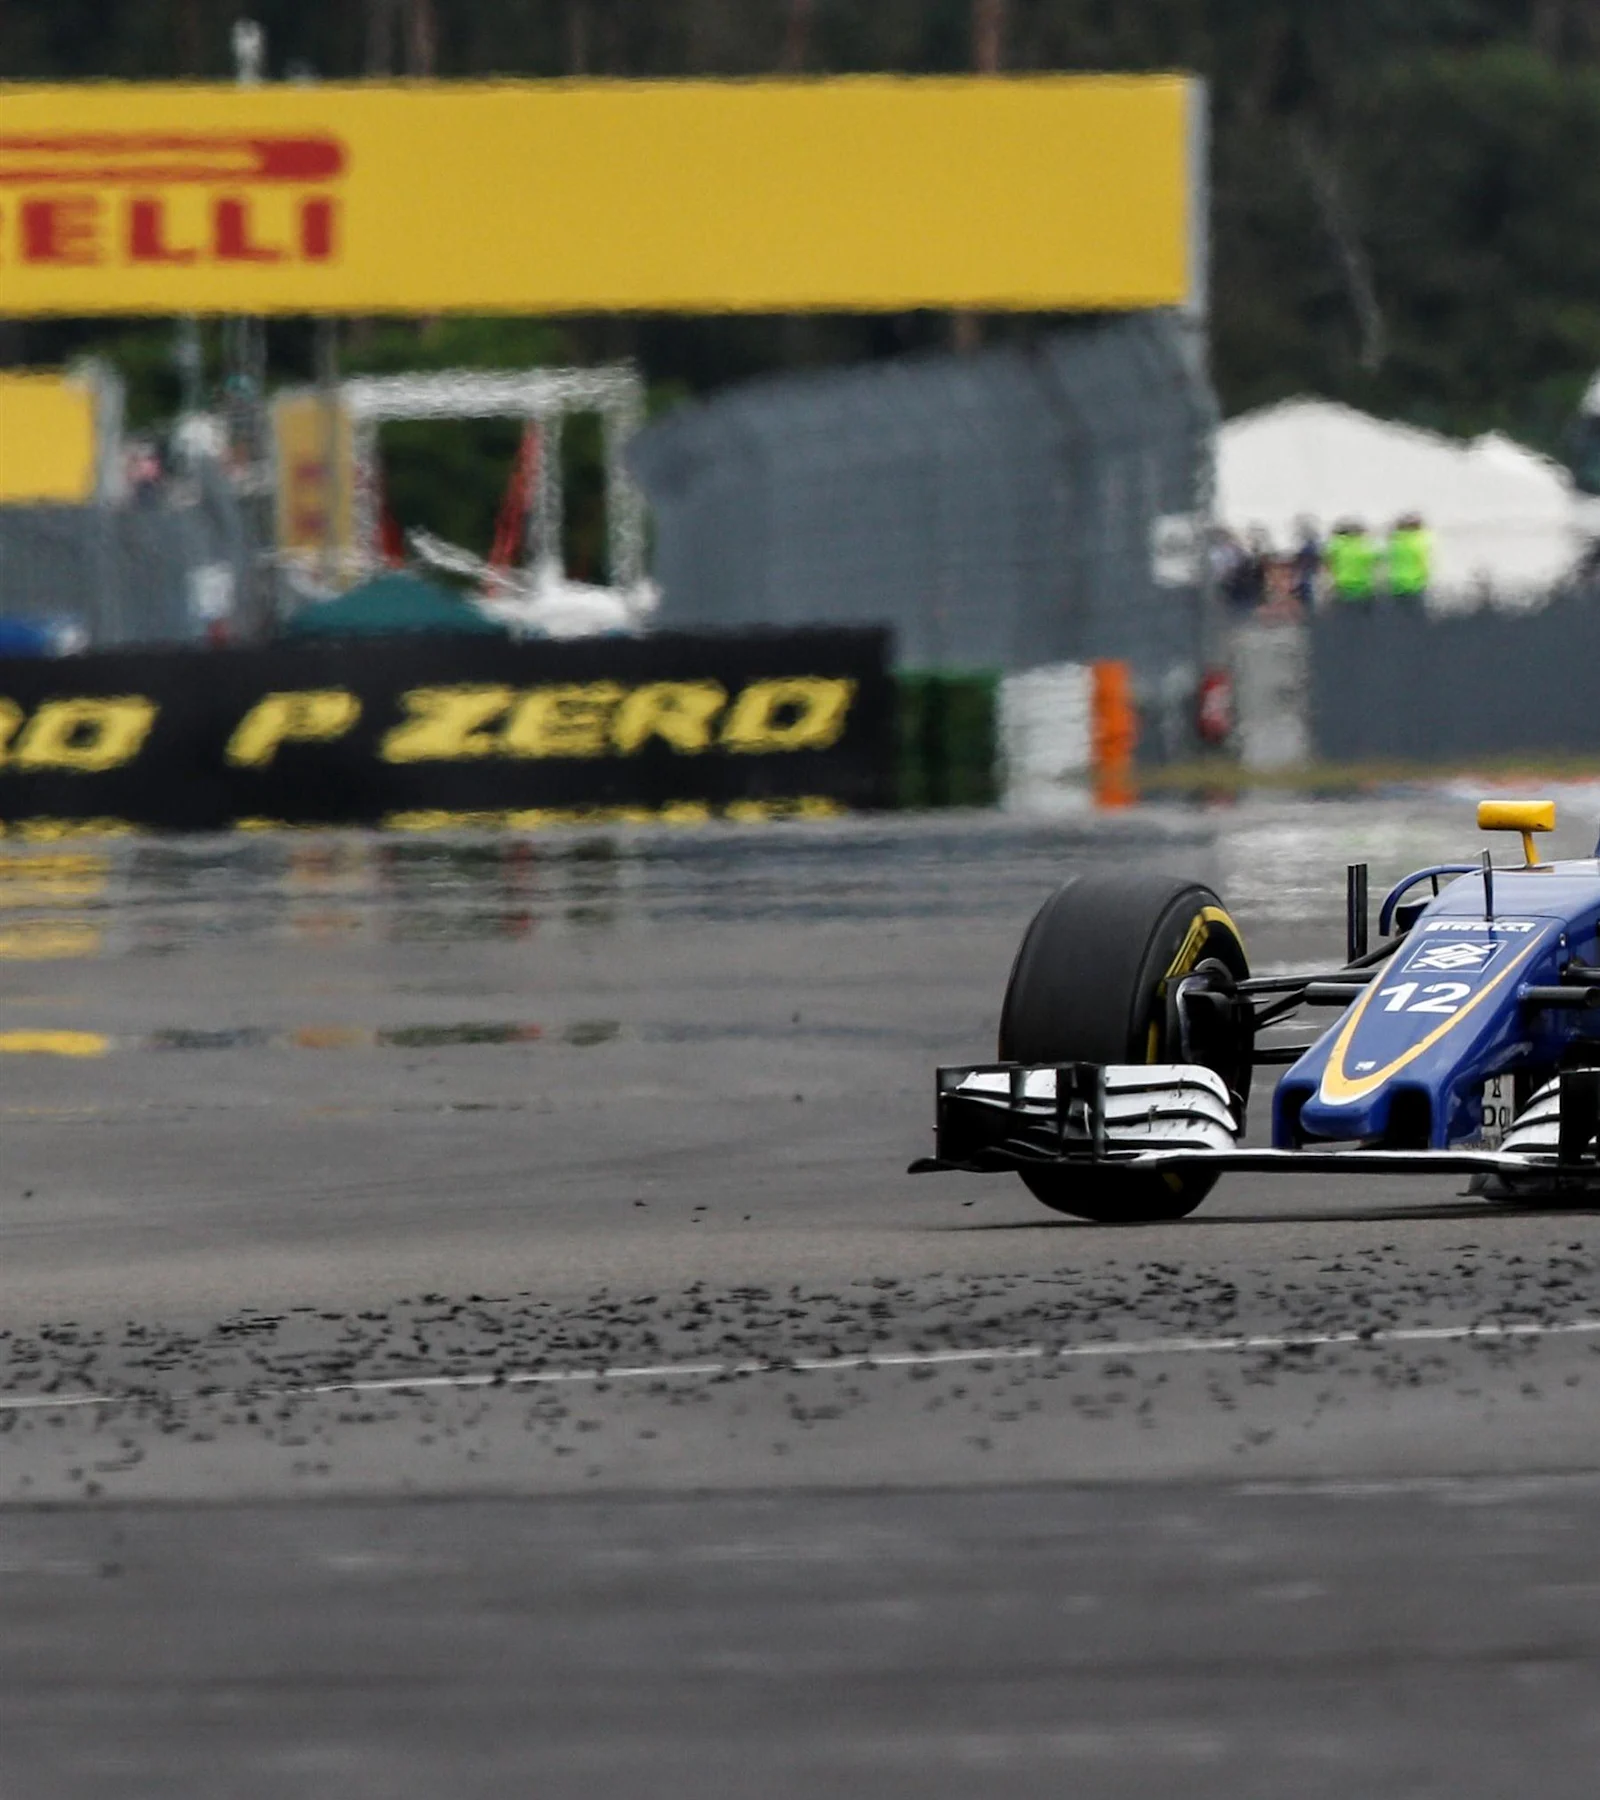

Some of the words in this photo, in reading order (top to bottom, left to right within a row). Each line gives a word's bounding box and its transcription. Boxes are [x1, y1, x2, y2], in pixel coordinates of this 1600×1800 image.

[0, 196, 336, 264] ELLI
[0, 693, 160, 772] O
[224, 688, 362, 768] P
[381, 676, 855, 763] ZERO
[1378, 981, 1472, 1014] 12
